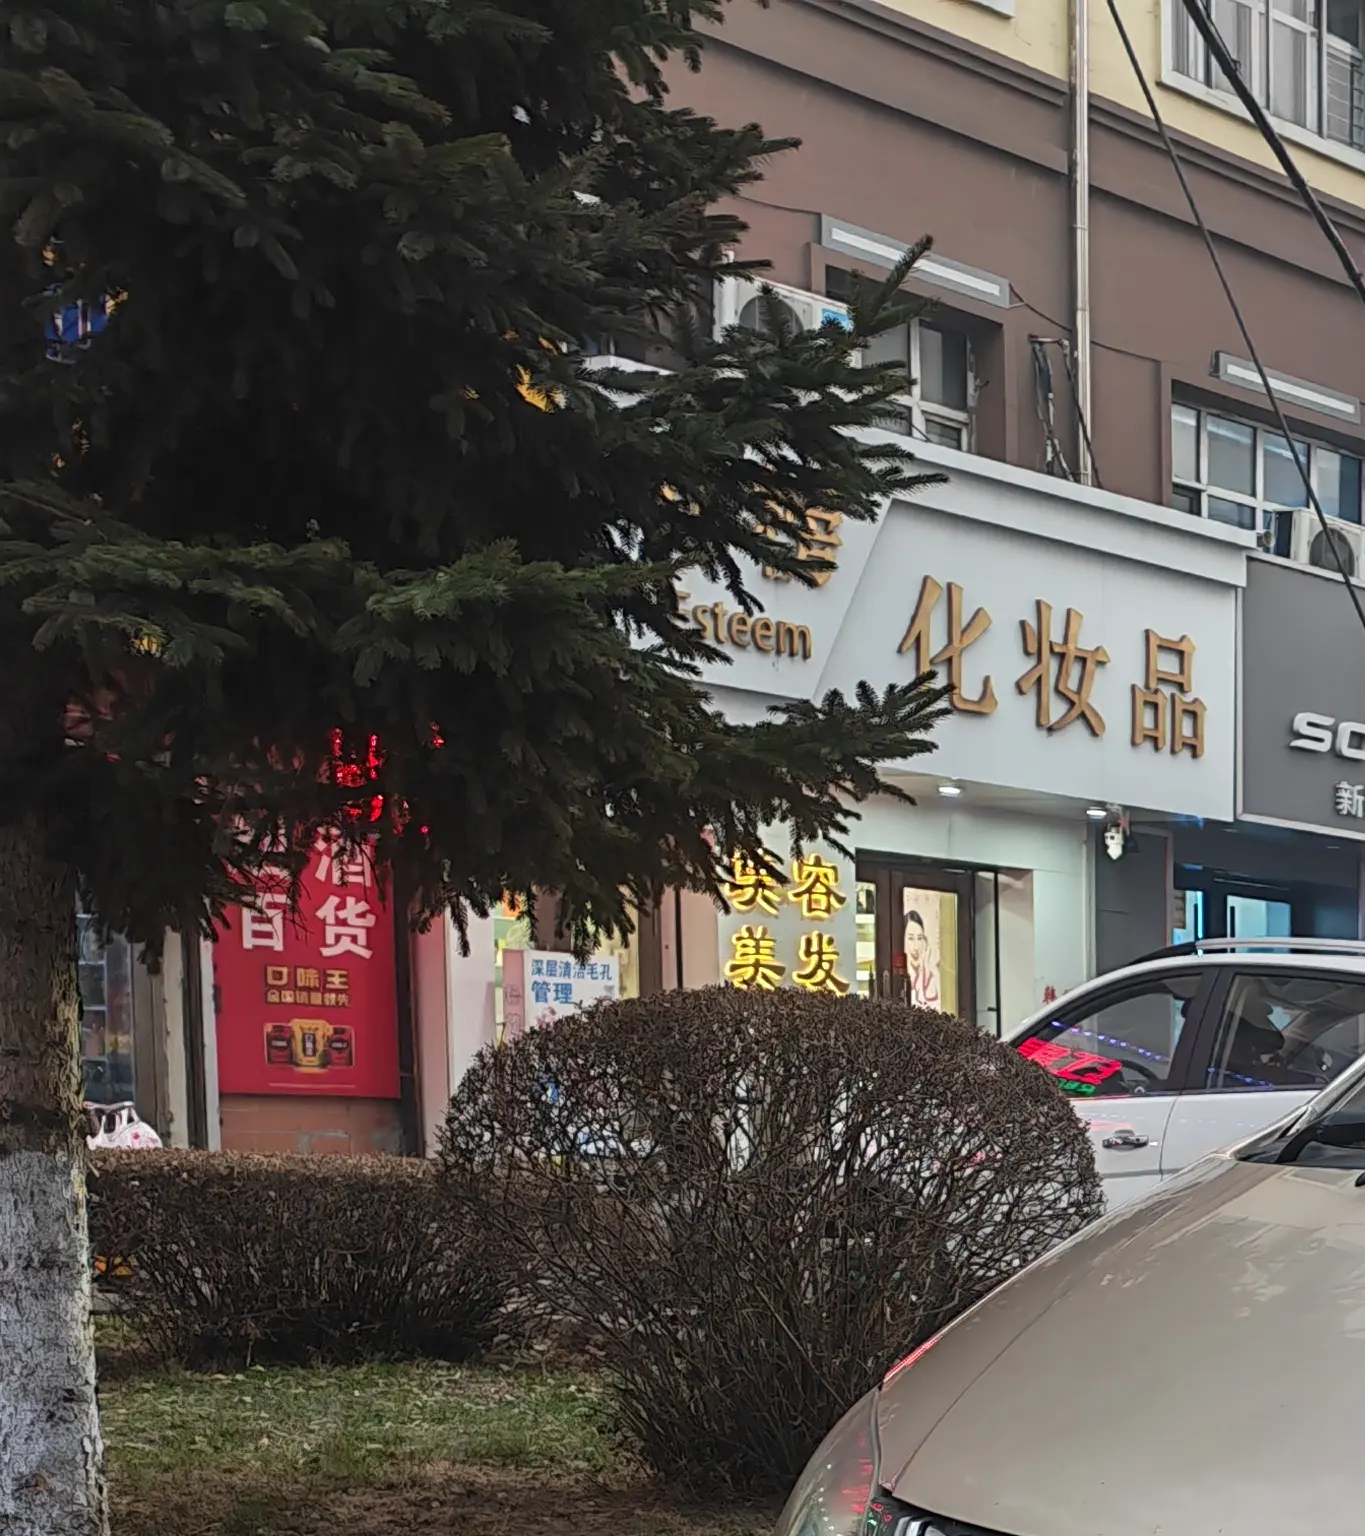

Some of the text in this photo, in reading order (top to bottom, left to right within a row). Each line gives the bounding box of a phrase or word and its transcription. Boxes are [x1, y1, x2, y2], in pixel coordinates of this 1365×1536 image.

[896, 573, 1208, 760] 化妆品
[722, 848, 848, 922] 美容
[239, 891, 377, 960] 百货
[724, 923, 851, 996] 美发
[531, 980, 573, 1005] 管理
